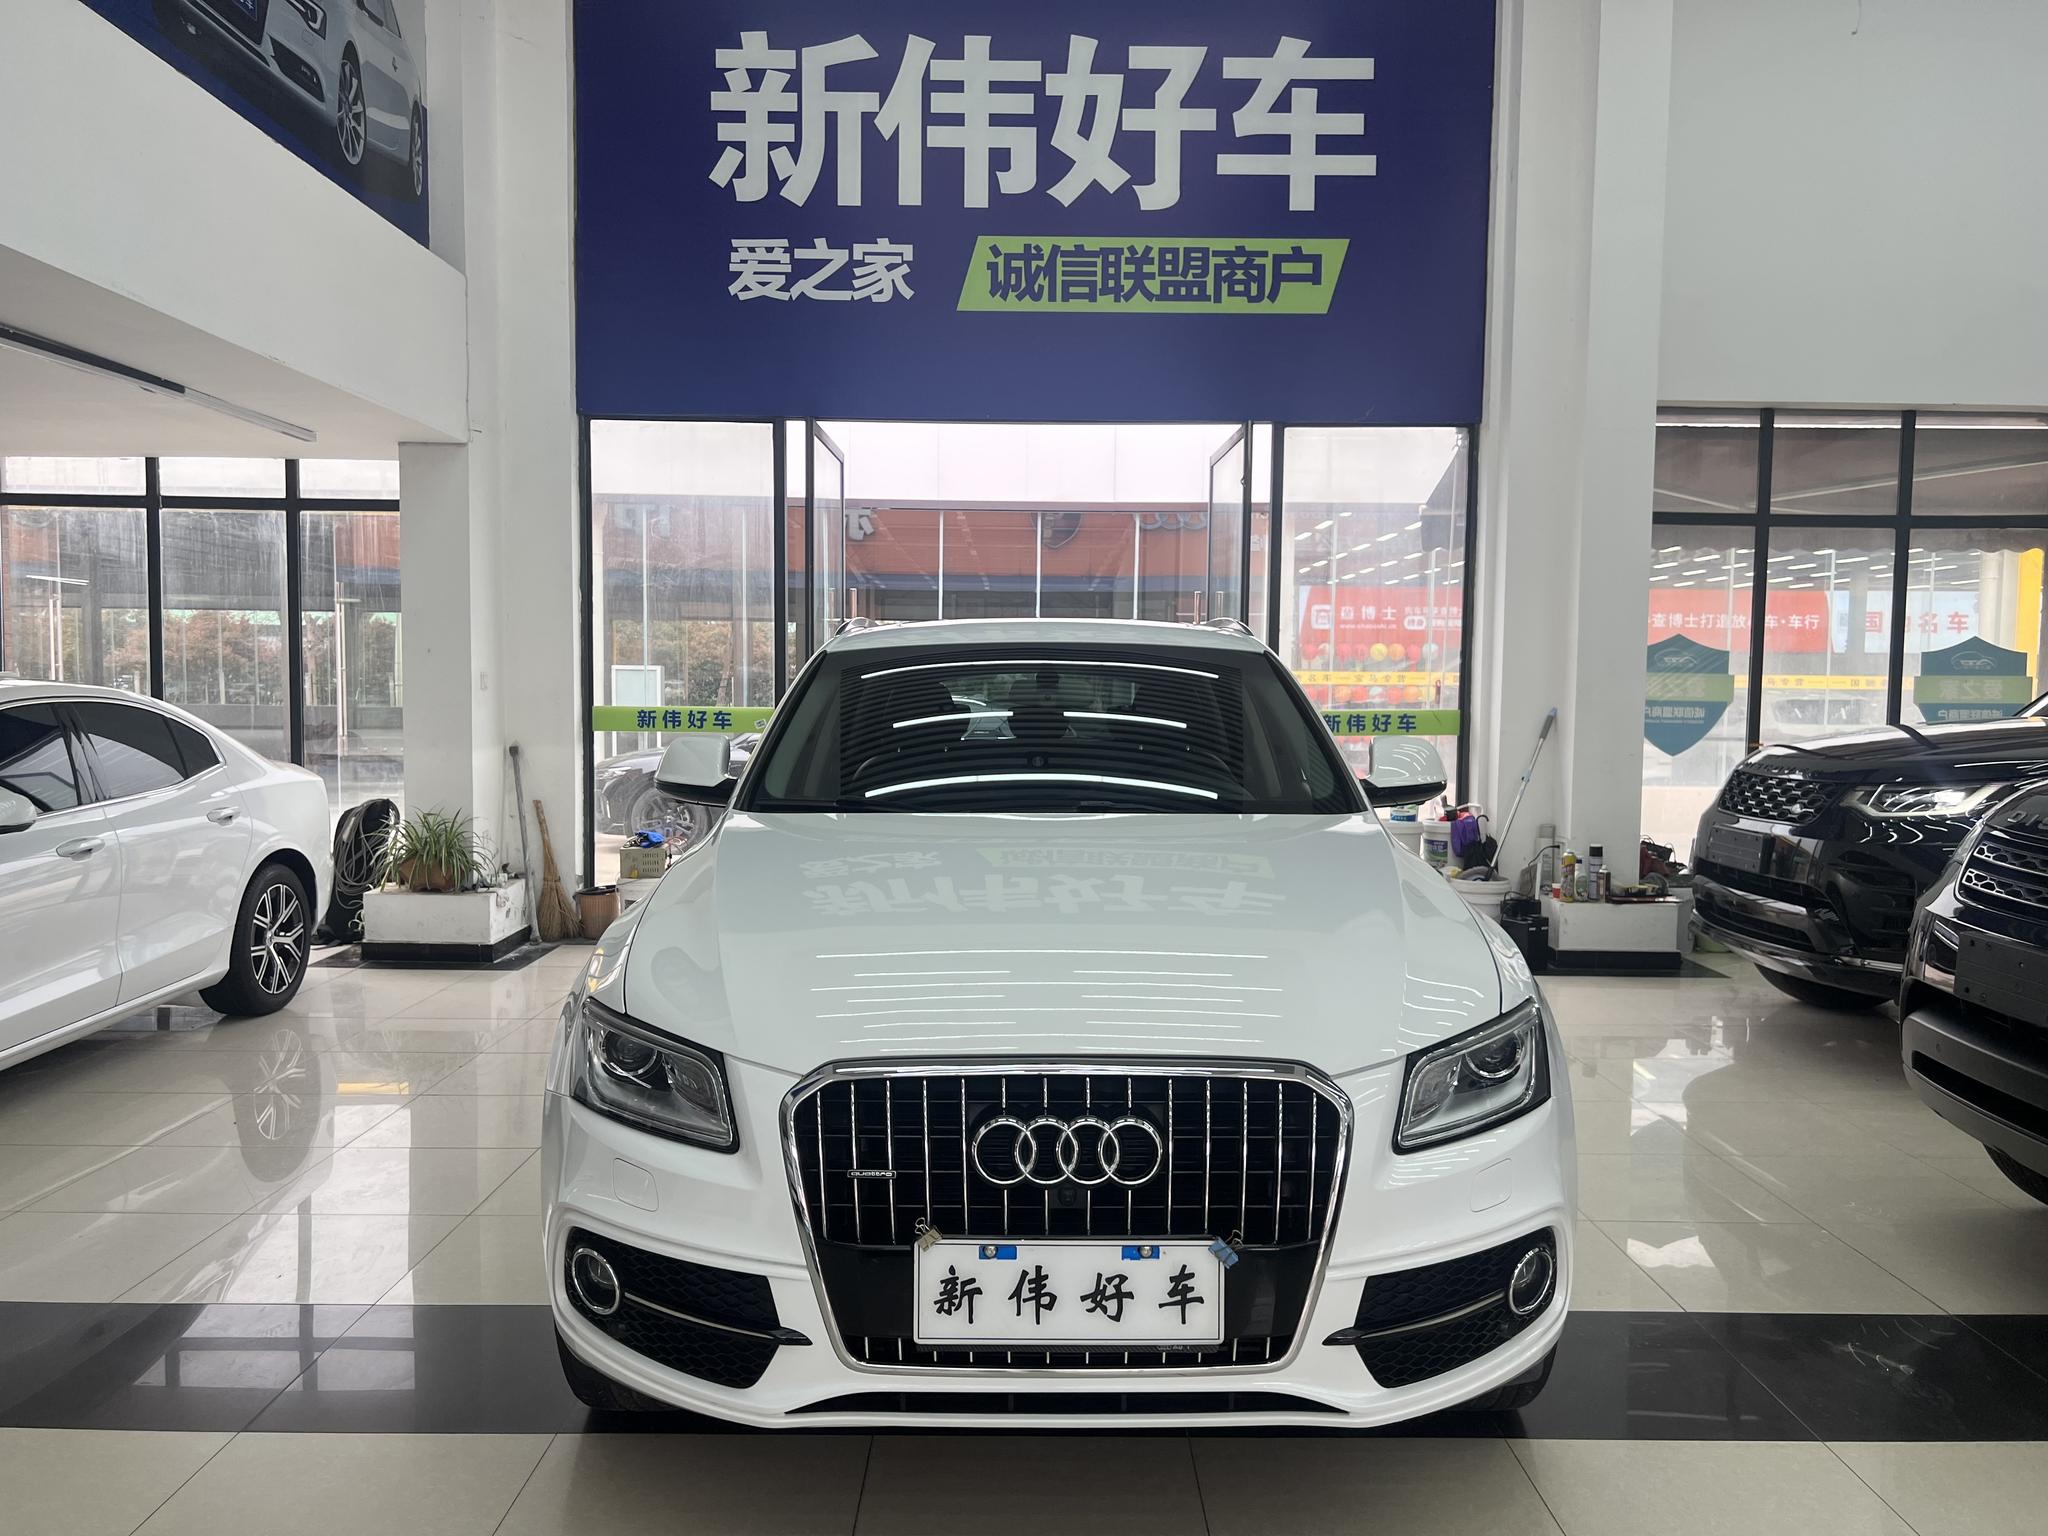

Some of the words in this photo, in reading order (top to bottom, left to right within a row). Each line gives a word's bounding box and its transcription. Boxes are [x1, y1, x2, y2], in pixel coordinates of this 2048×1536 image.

[709, 31, 1378, 211] 新伟好车
[728, 237, 915, 303] 爱之家
[988, 244, 1323, 303] 诚信联盟商户
[1866, 611, 1969, 635] 国名车
[637, 710, 733, 730] 新伟好车
[1323, 713, 1417, 733] 新伟好车
[934, 1264, 1205, 1325] 新伟好车
